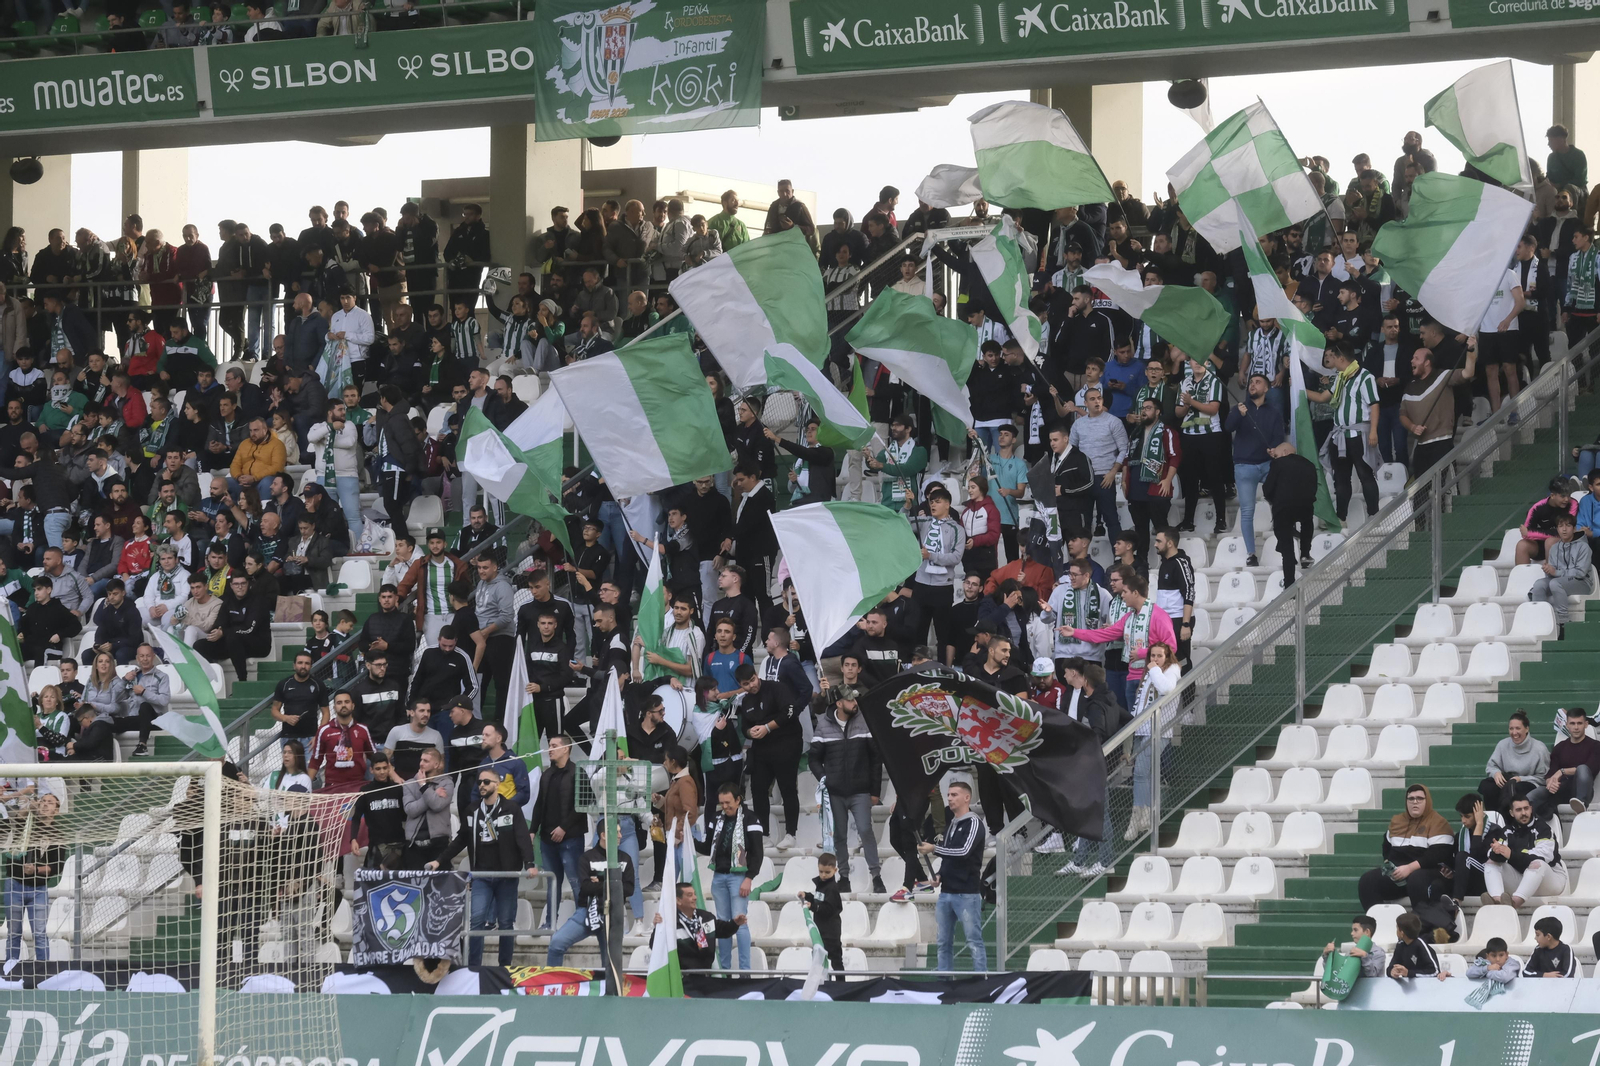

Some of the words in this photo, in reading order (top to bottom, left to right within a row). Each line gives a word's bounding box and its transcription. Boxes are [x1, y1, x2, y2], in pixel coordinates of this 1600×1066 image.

[682, 3, 710, 16] PEÑA
[1050, 0, 1170, 33] CaixaBank
[853, 13, 970, 48] CaixaBank
[430, 46, 534, 77] SILBO
[673, 37, 717, 57] Infantil
[251, 58, 377, 91] SILBON
[610, 108, 629, 118] 2021
[1135, 612, 1146, 633] C.F.
[920, 738, 989, 776] CÓR
